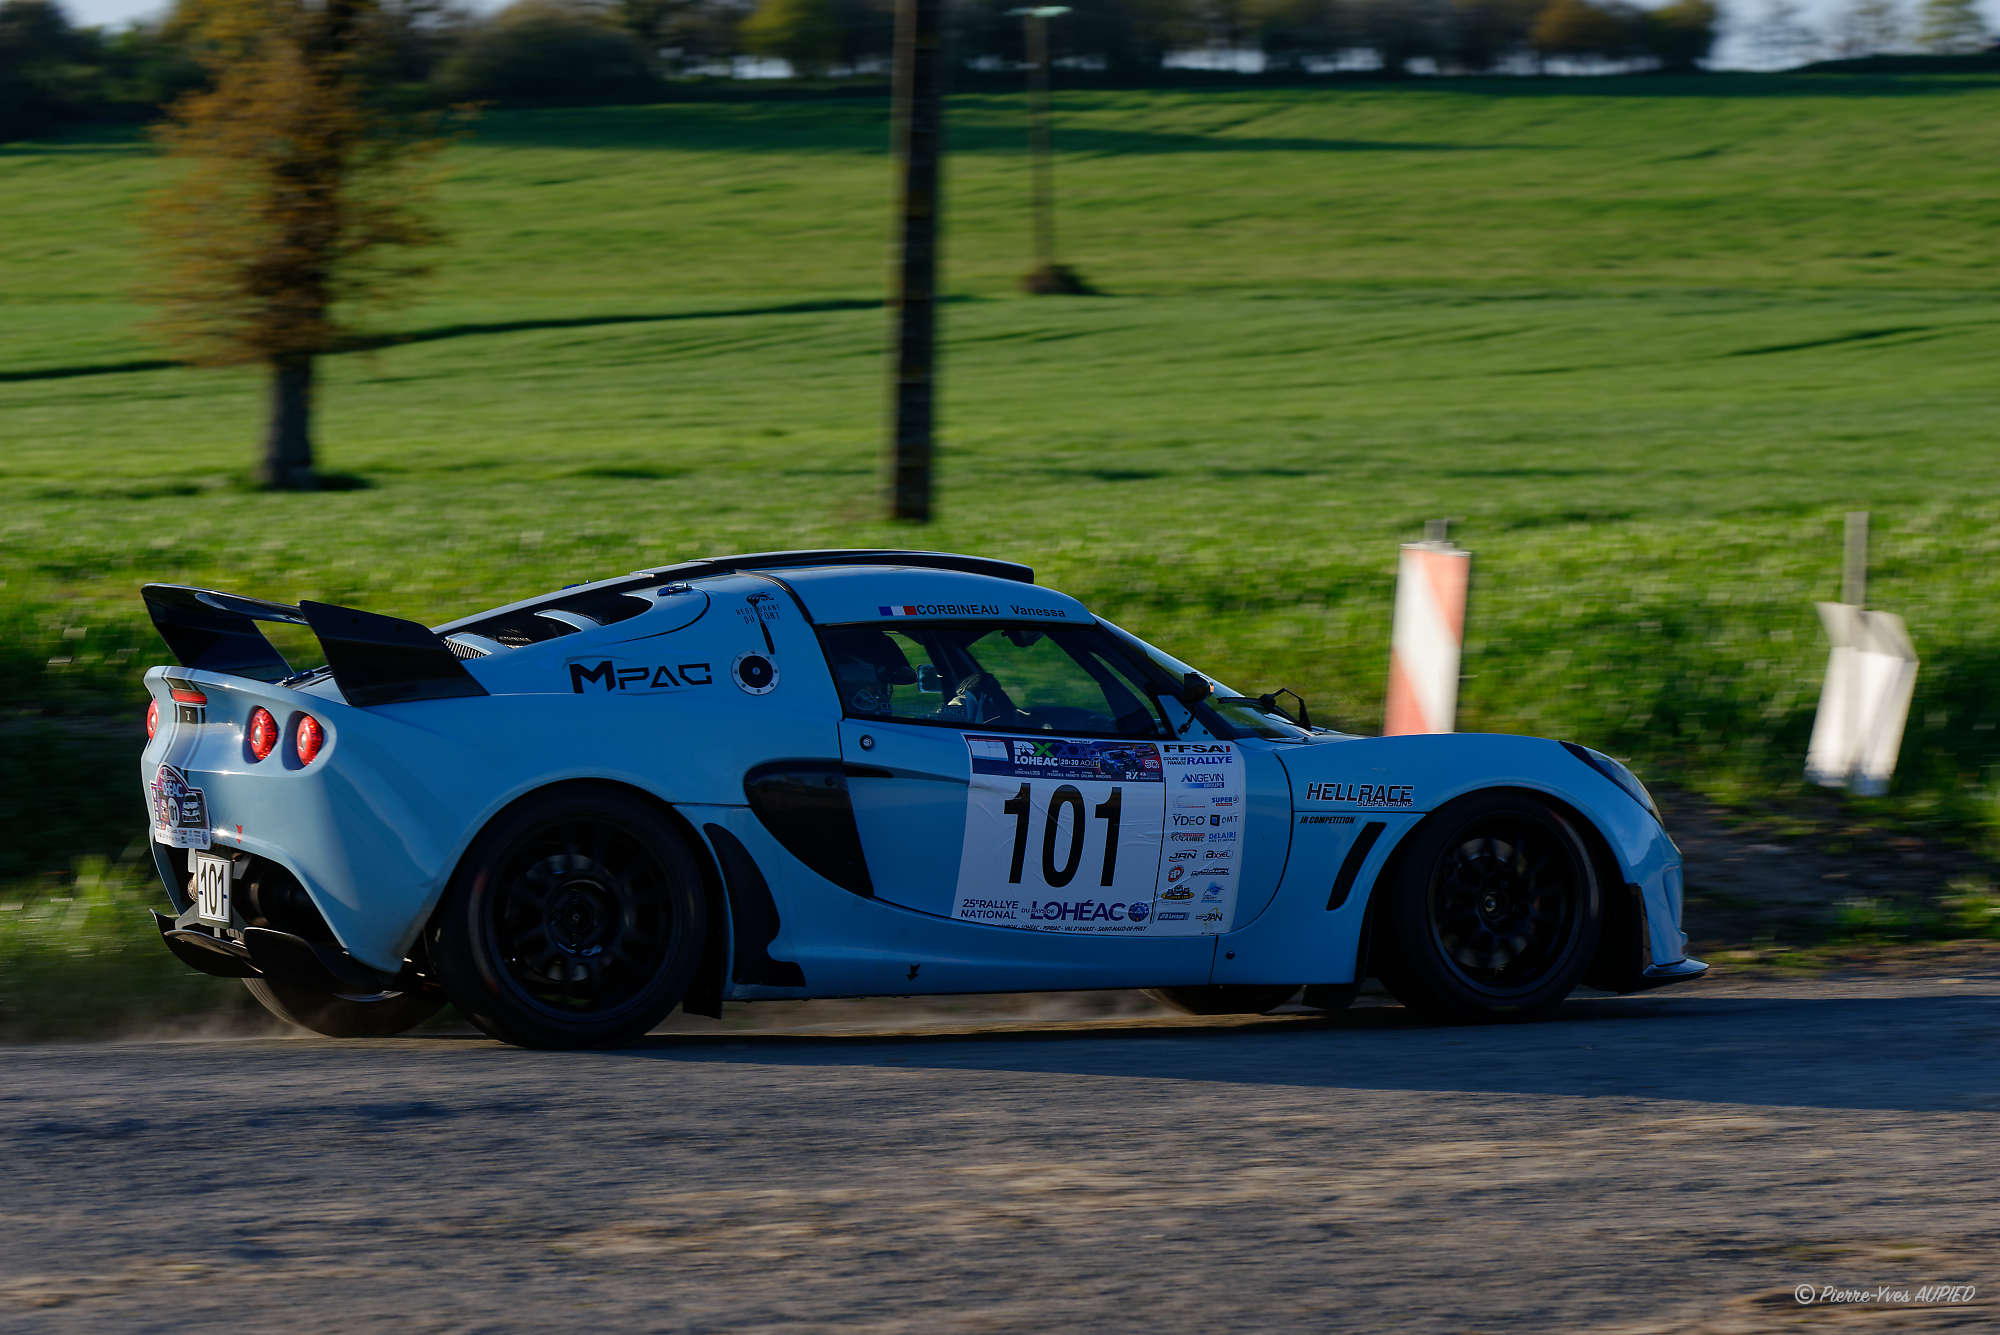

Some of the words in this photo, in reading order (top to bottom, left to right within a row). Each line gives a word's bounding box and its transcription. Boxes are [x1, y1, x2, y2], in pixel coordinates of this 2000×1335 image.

[917, 604, 1000, 616] CORBINEAU
[1010, 605, 1066, 618] Vanessa
[569, 661, 712, 694] MPAC
[1163, 744, 1225, 753] FFSA
[1014, 756, 1058, 766] LOHEAC
[1186, 756, 1232, 765] RALLYE
[1181, 773, 1225, 783] ANGEVIN
[1306, 782, 1414, 803] HELLRACE
[1004, 782, 1121, 888] 101
[200, 861, 224, 917] 101
[978, 899, 1019, 909] RALLYE
[960, 910, 1017, 919] NATIONAL
[1030, 900, 1126, 921] LOHÉAC
